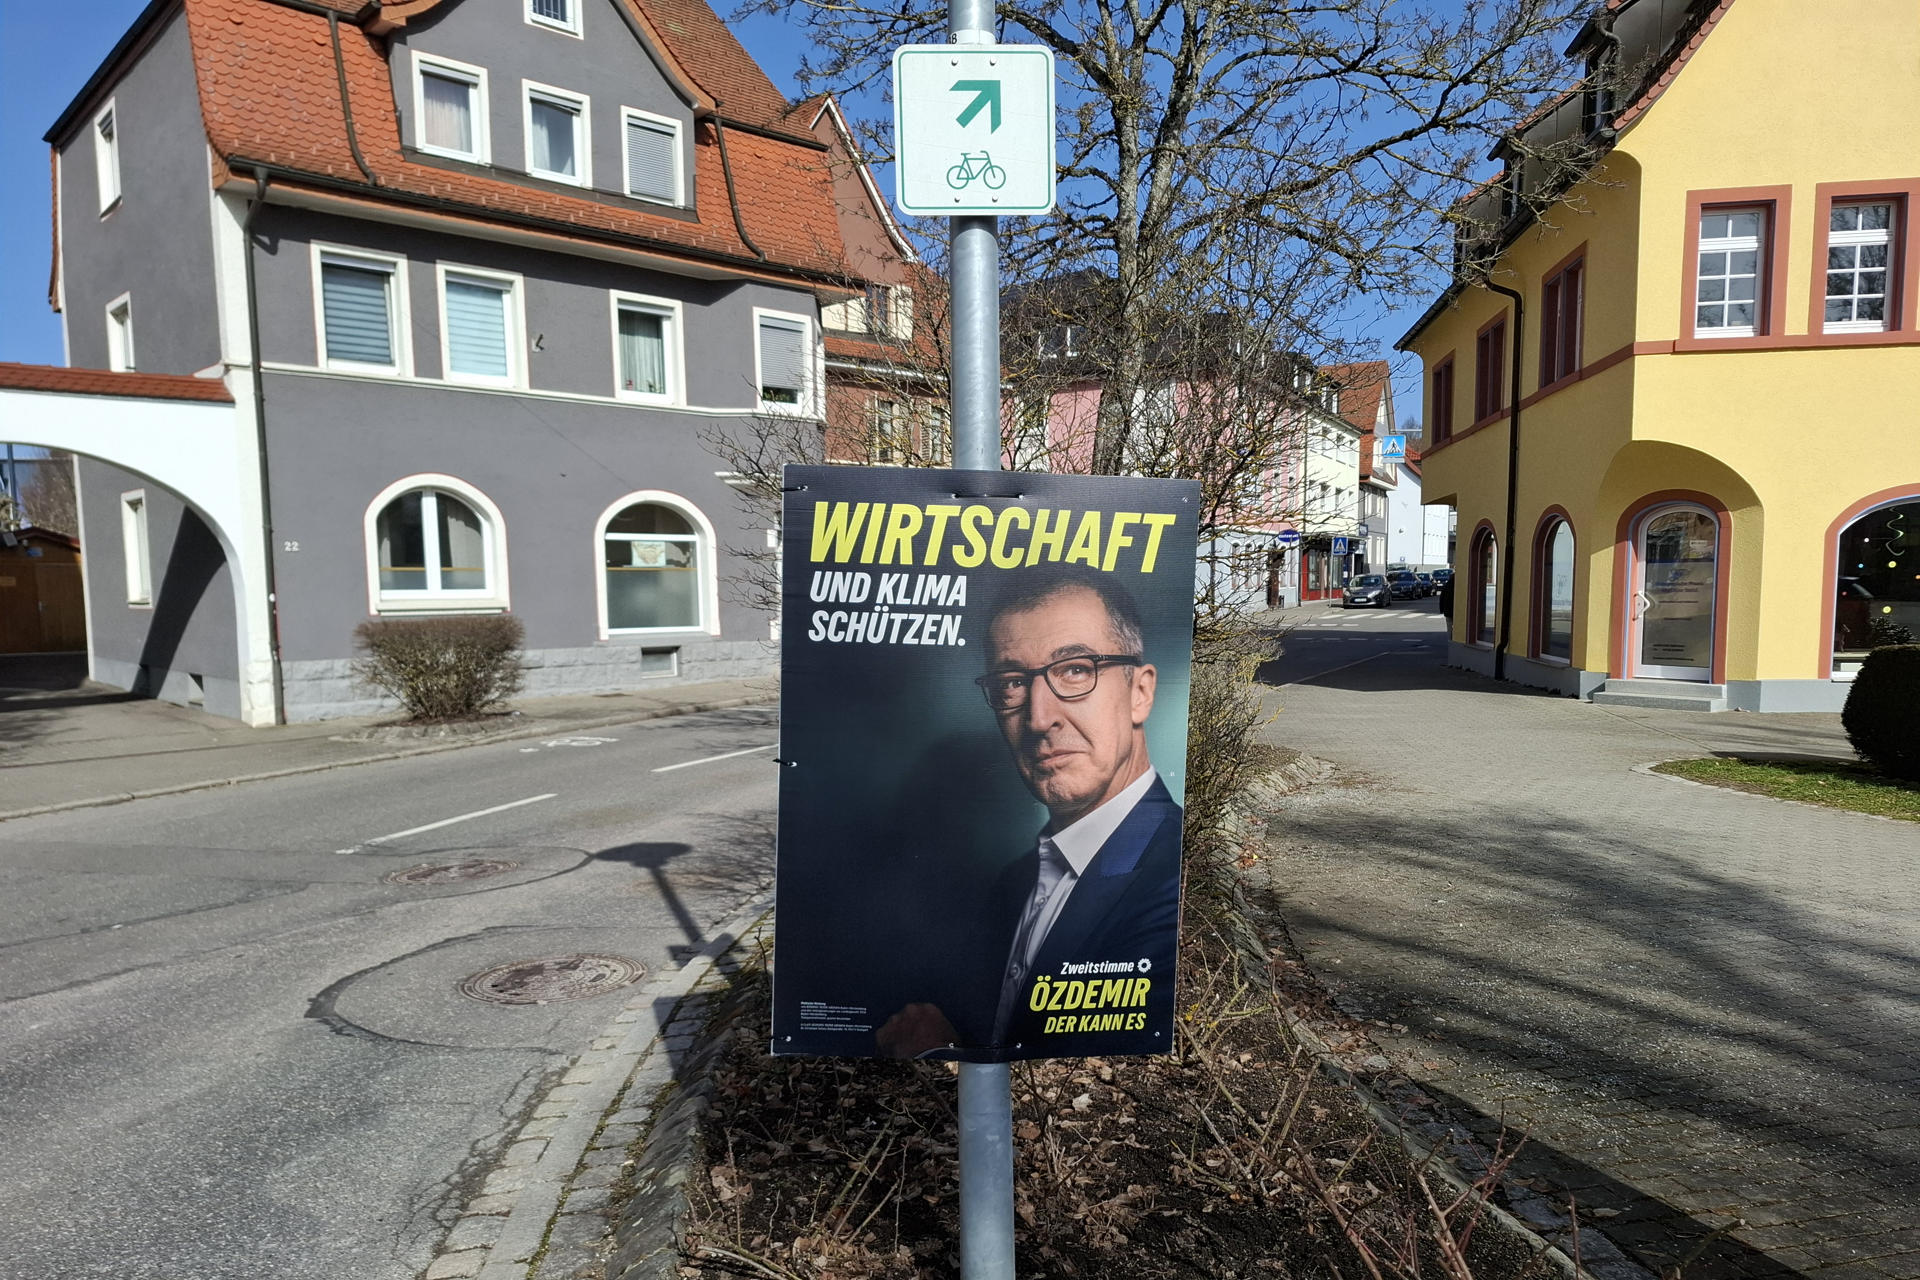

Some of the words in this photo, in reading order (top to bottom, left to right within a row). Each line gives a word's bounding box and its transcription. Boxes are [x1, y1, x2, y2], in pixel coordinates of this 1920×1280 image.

[284, 541, 299, 551] 22
[810, 501, 1177, 573] WIRTSCHAFT
[809, 570, 872, 603] UND
[875, 573, 967, 607] KLIMA
[808, 605, 966, 646] SCHÜTZEN.
[1060, 961, 1135, 975] Zweitstimme
[1029, 975, 1151, 1012] ÖZDEMIR
[1044, 1015, 1077, 1034] DER
[1078, 1013, 1124, 1032] KANN
[1125, 1012, 1147, 1030] ES
